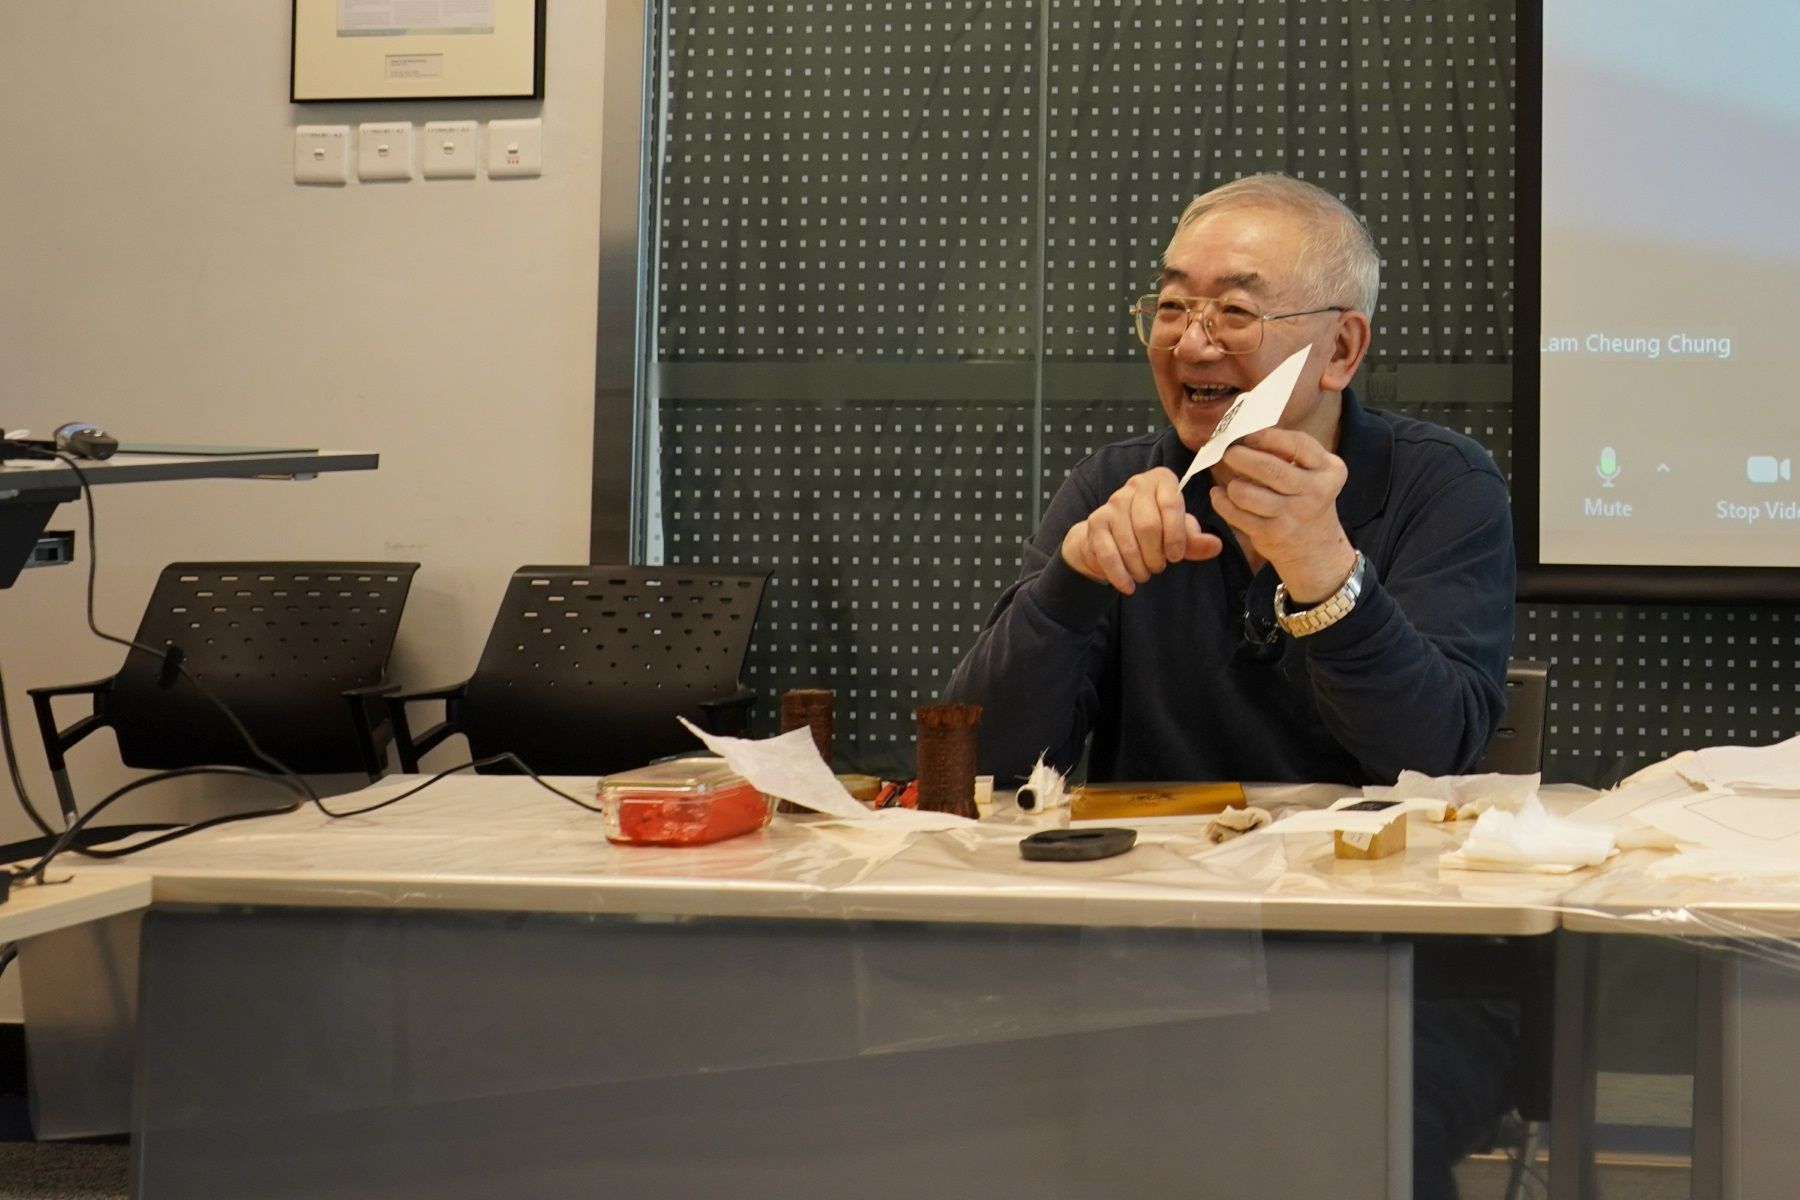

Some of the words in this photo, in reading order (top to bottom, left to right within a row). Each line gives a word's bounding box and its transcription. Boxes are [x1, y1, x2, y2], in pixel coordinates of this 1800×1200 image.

[1585, 334, 1661, 358] Cheung
[1667, 333, 1731, 358] Chung
[1584, 498, 1633, 517] Mute
[1716, 501, 1760, 524] Stop
